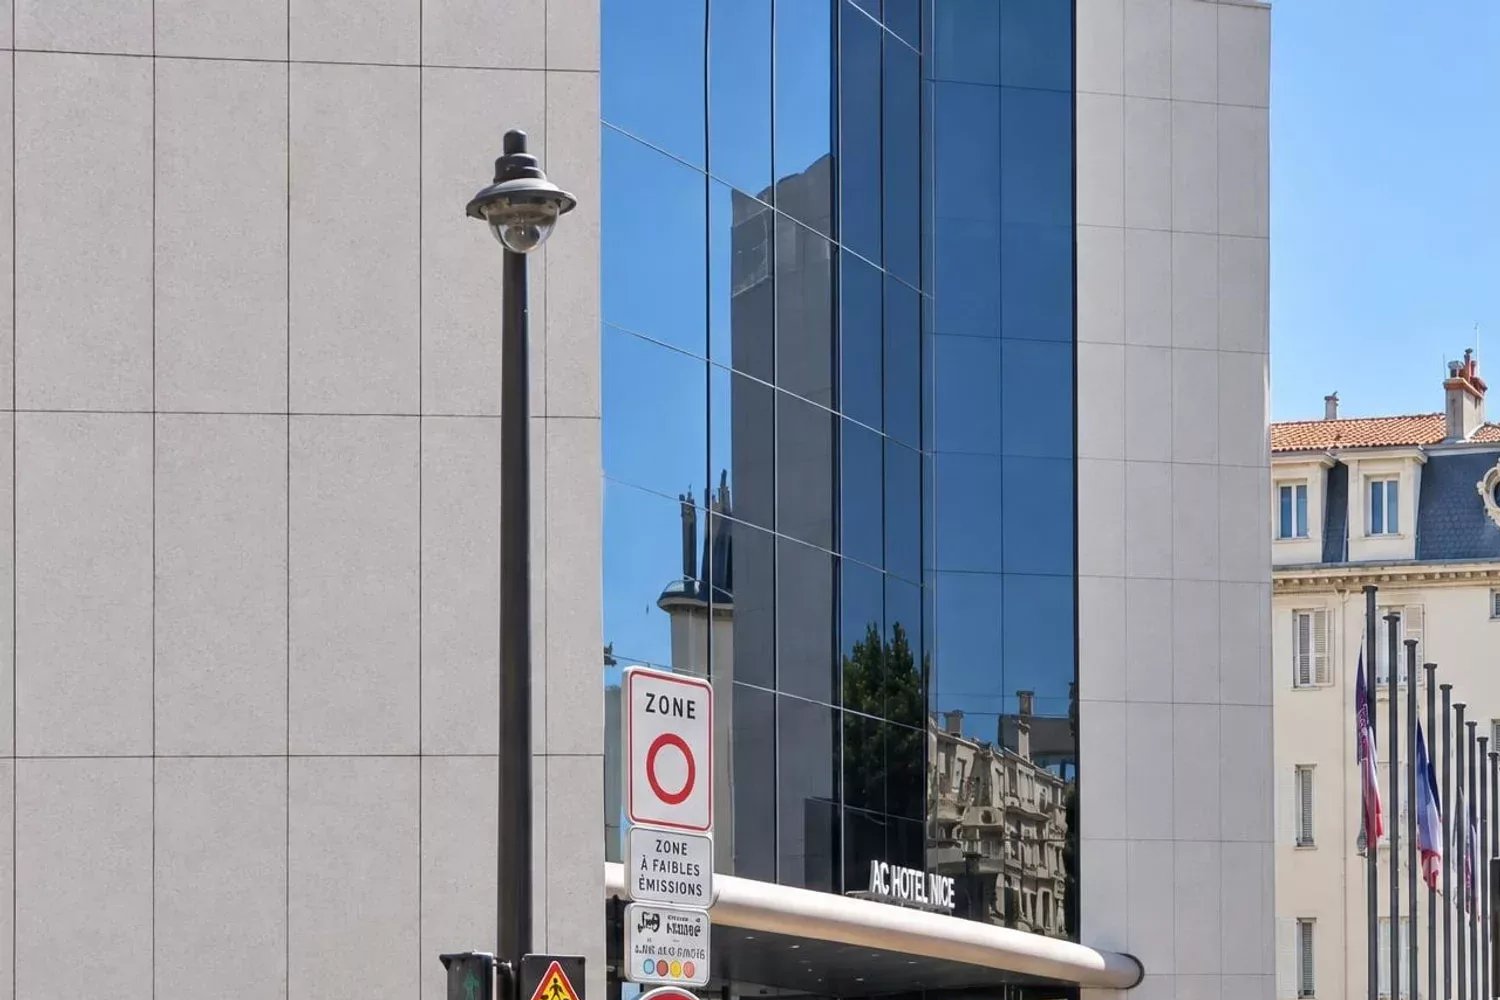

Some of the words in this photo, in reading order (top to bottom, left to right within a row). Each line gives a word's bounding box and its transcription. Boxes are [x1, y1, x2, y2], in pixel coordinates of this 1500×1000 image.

[645, 692, 696, 720] ZONE
[656, 839, 688, 856] ZONE
[640, 854, 648, 871] À
[652, 859, 700, 877] FAIBLES
[638, 874, 703, 897] ÉMISSIONS
[870, 860, 890, 896] AC
[891, 865, 928, 903] HOTEL
[929, 873, 955, 908] NICE
